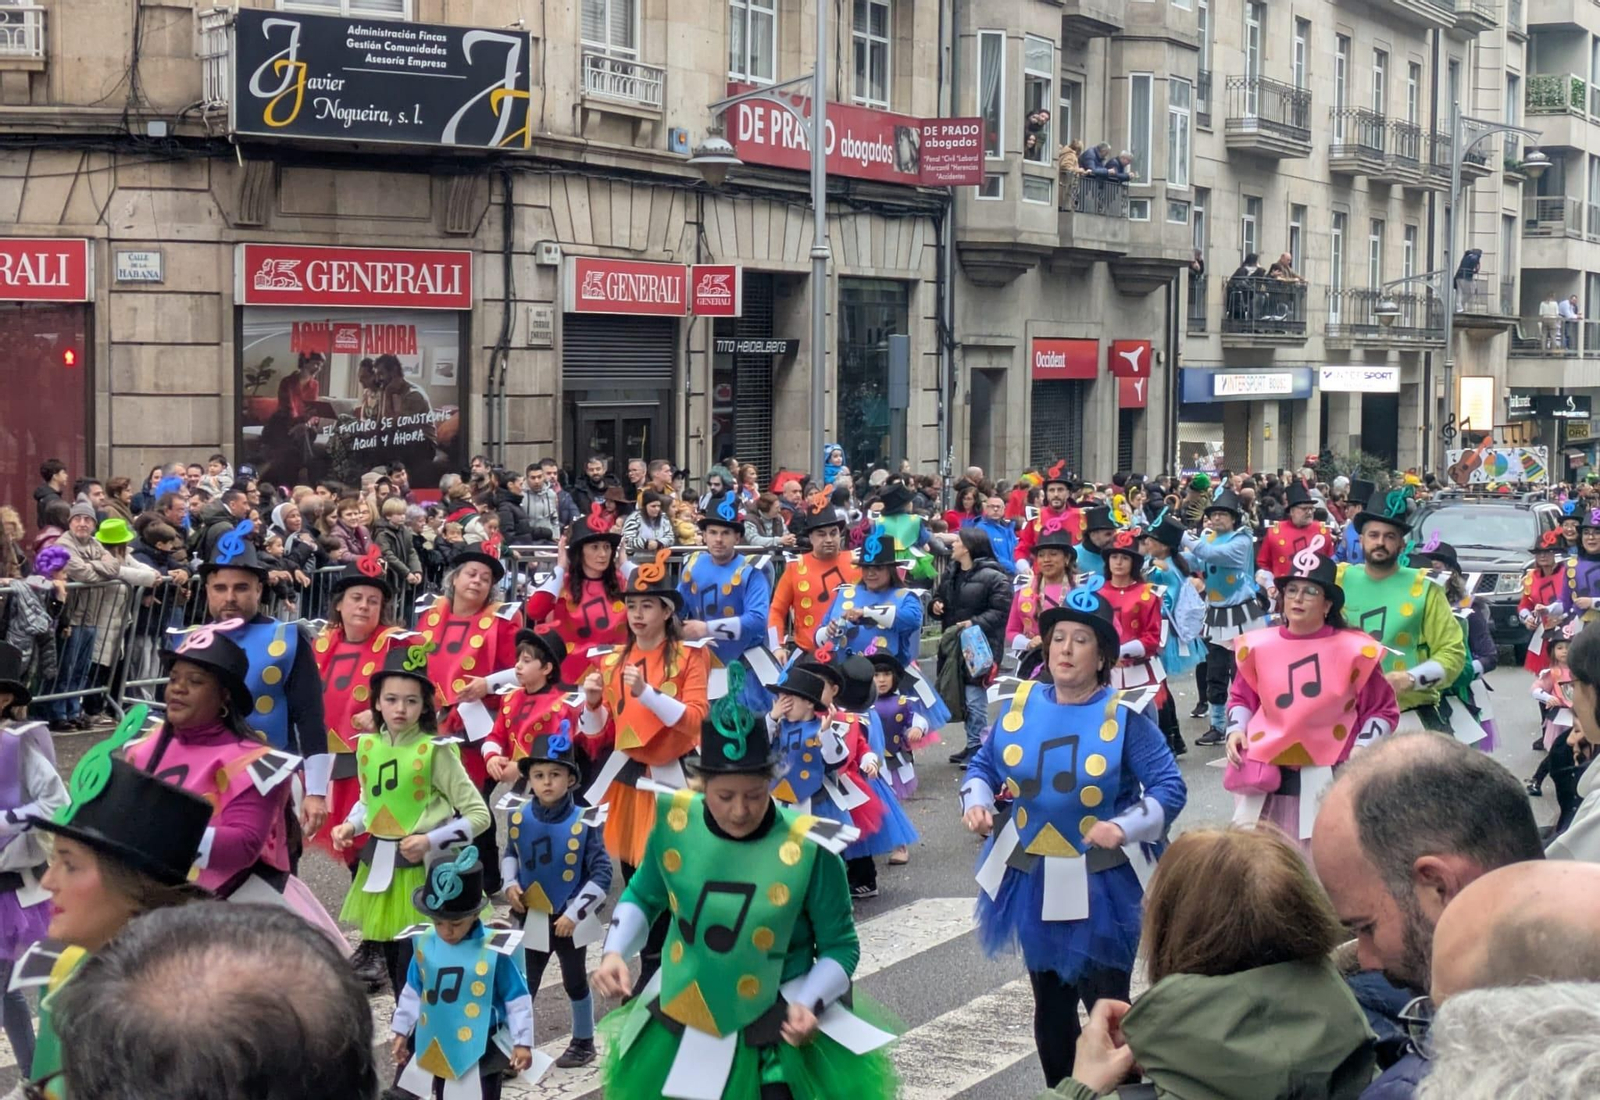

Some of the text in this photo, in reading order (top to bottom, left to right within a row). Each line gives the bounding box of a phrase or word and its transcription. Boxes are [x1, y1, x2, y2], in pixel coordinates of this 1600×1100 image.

[347, 25, 447, 42] Administración Fincas
[346, 38, 447, 55] Gestión Comunidades
[365, 53, 447, 68] Asesoría Empresa
[313, 97, 393, 128] Nogueira,
[397, 112, 408, 124] s.
[739, 103, 893, 167] DE PRAO abogados
[923, 124, 979, 136] DE PRADO
[925, 136, 977, 149] abogados
[0, 252, 70, 286] RALI
[119, 269, 159, 279] HABANA
[305, 261, 463, 296] GENERALI
[606, 272, 681, 304] GENERALI
[696, 297, 731, 306] GENERALI
[364, 324, 418, 355] AHORA
[716, 340, 735, 353] TITO
[1035, 350, 1066, 368] Occident
[322, 409, 452, 437] EL FUTURO SE CONSTRUYE
[353, 435, 377, 450] AQUÍ
[381, 434, 388, 447] Y
